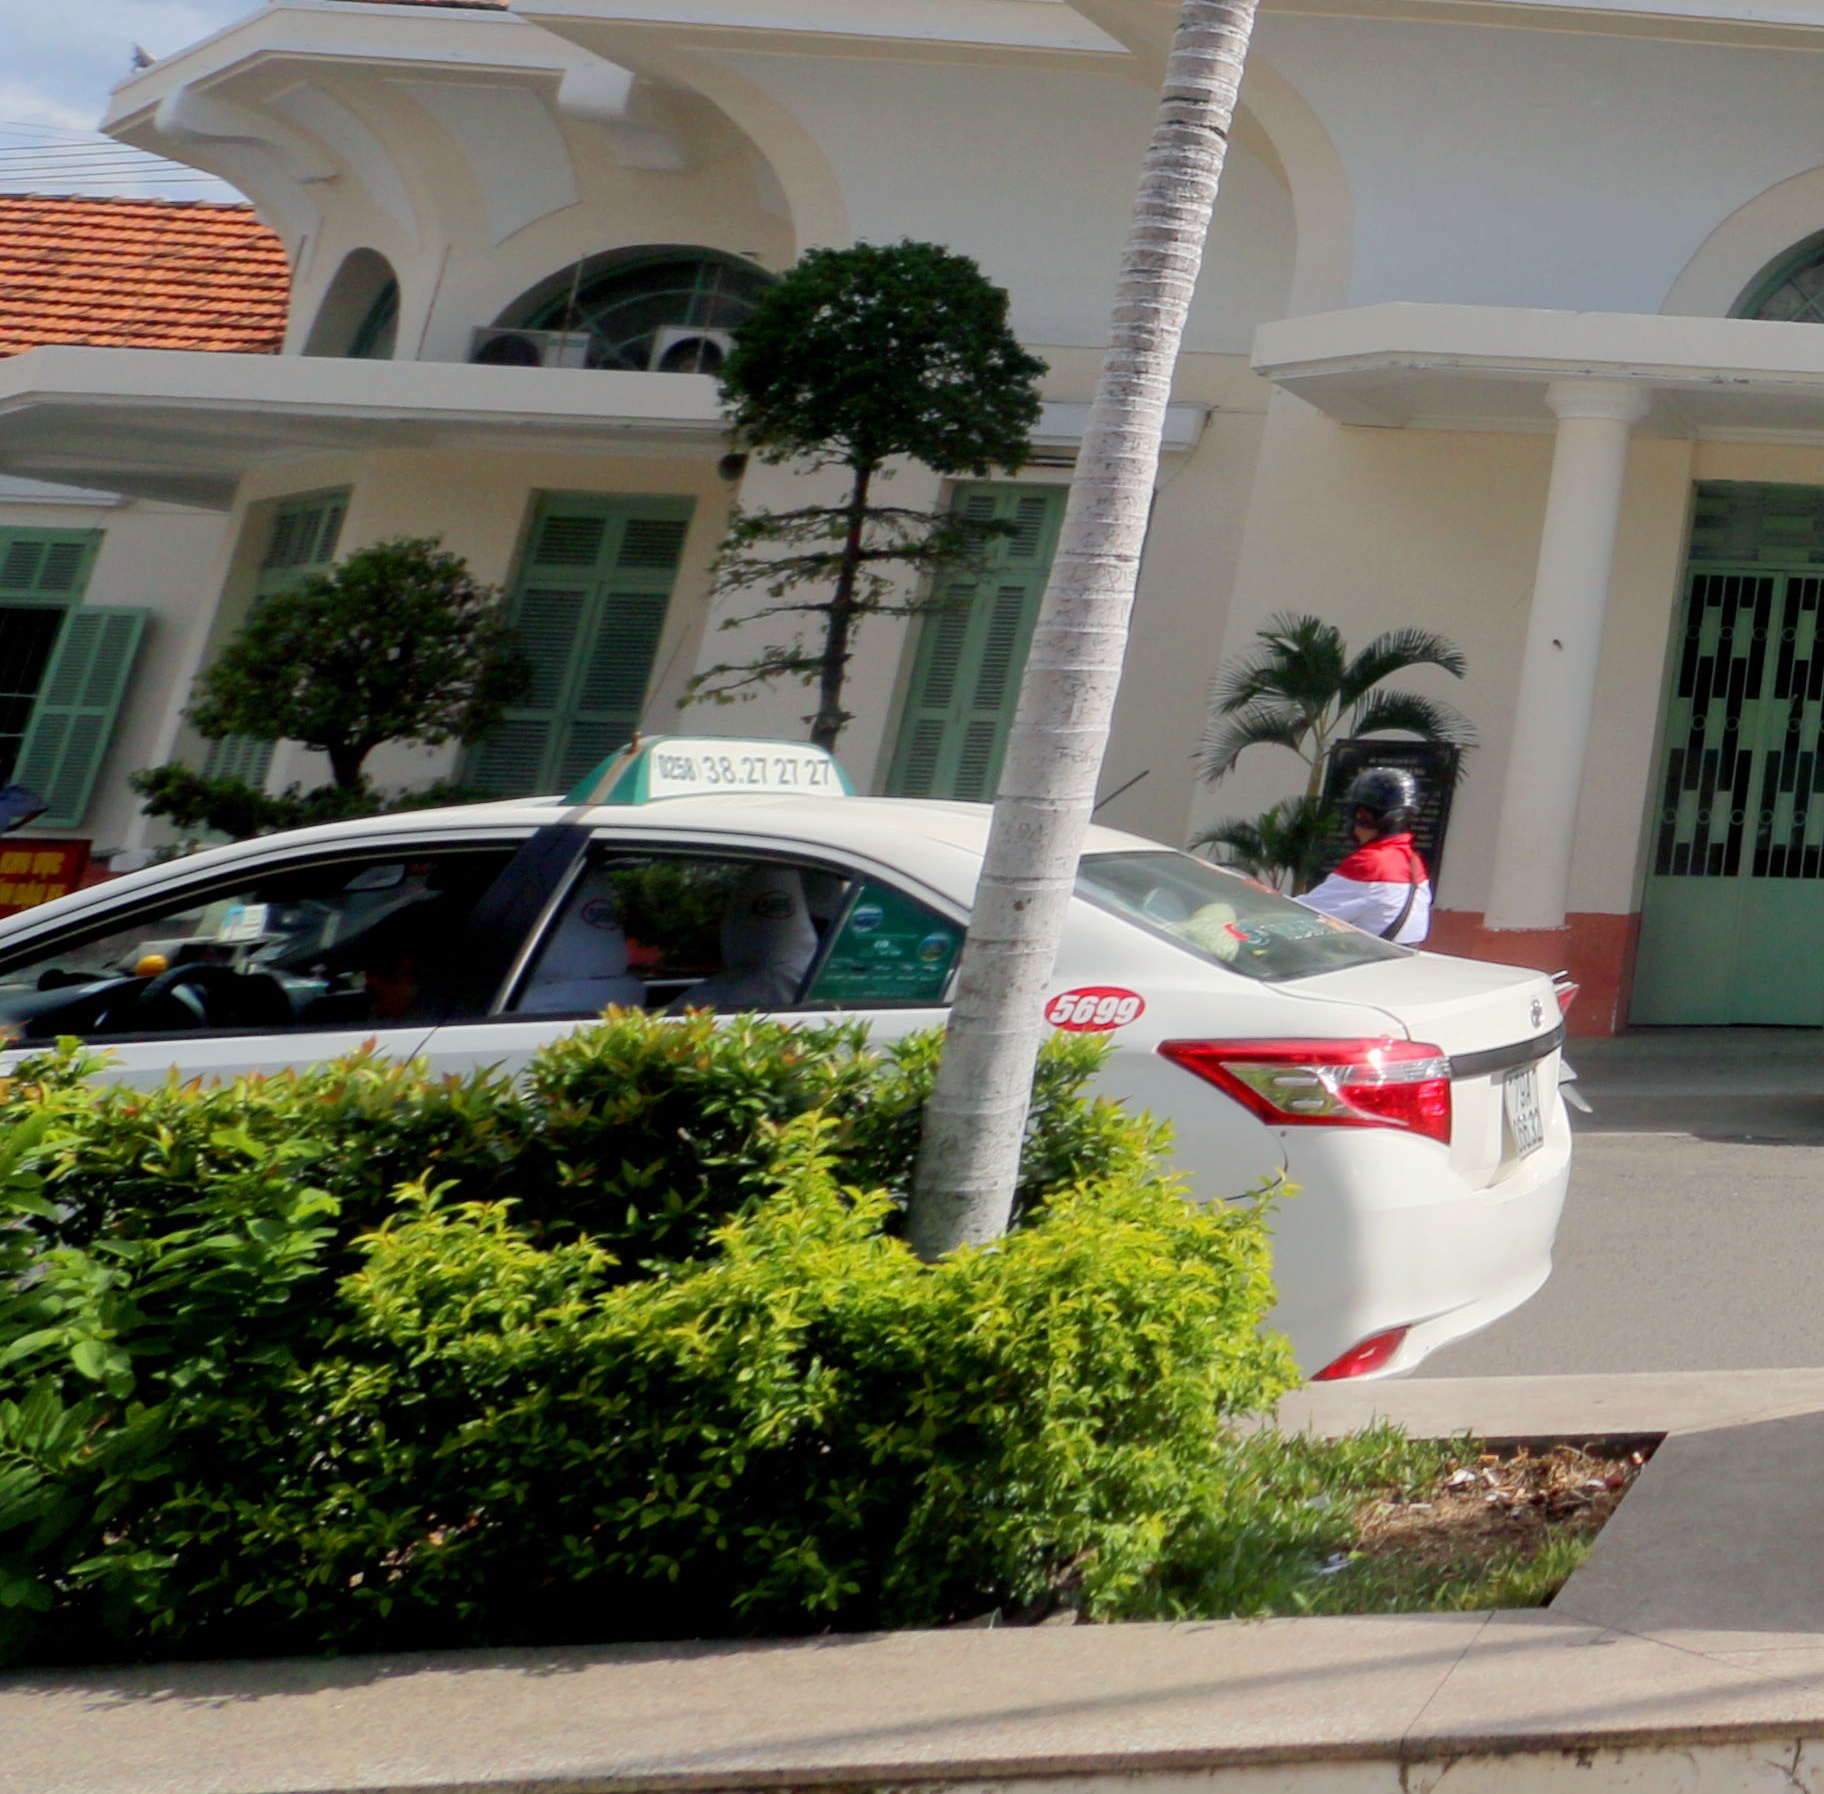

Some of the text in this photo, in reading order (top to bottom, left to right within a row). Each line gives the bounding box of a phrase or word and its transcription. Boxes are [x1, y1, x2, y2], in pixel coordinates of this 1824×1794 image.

[773, 758, 799, 786] 27
[804, 758, 830, 786] 27
[1049, 994, 1141, 1026] 5699
